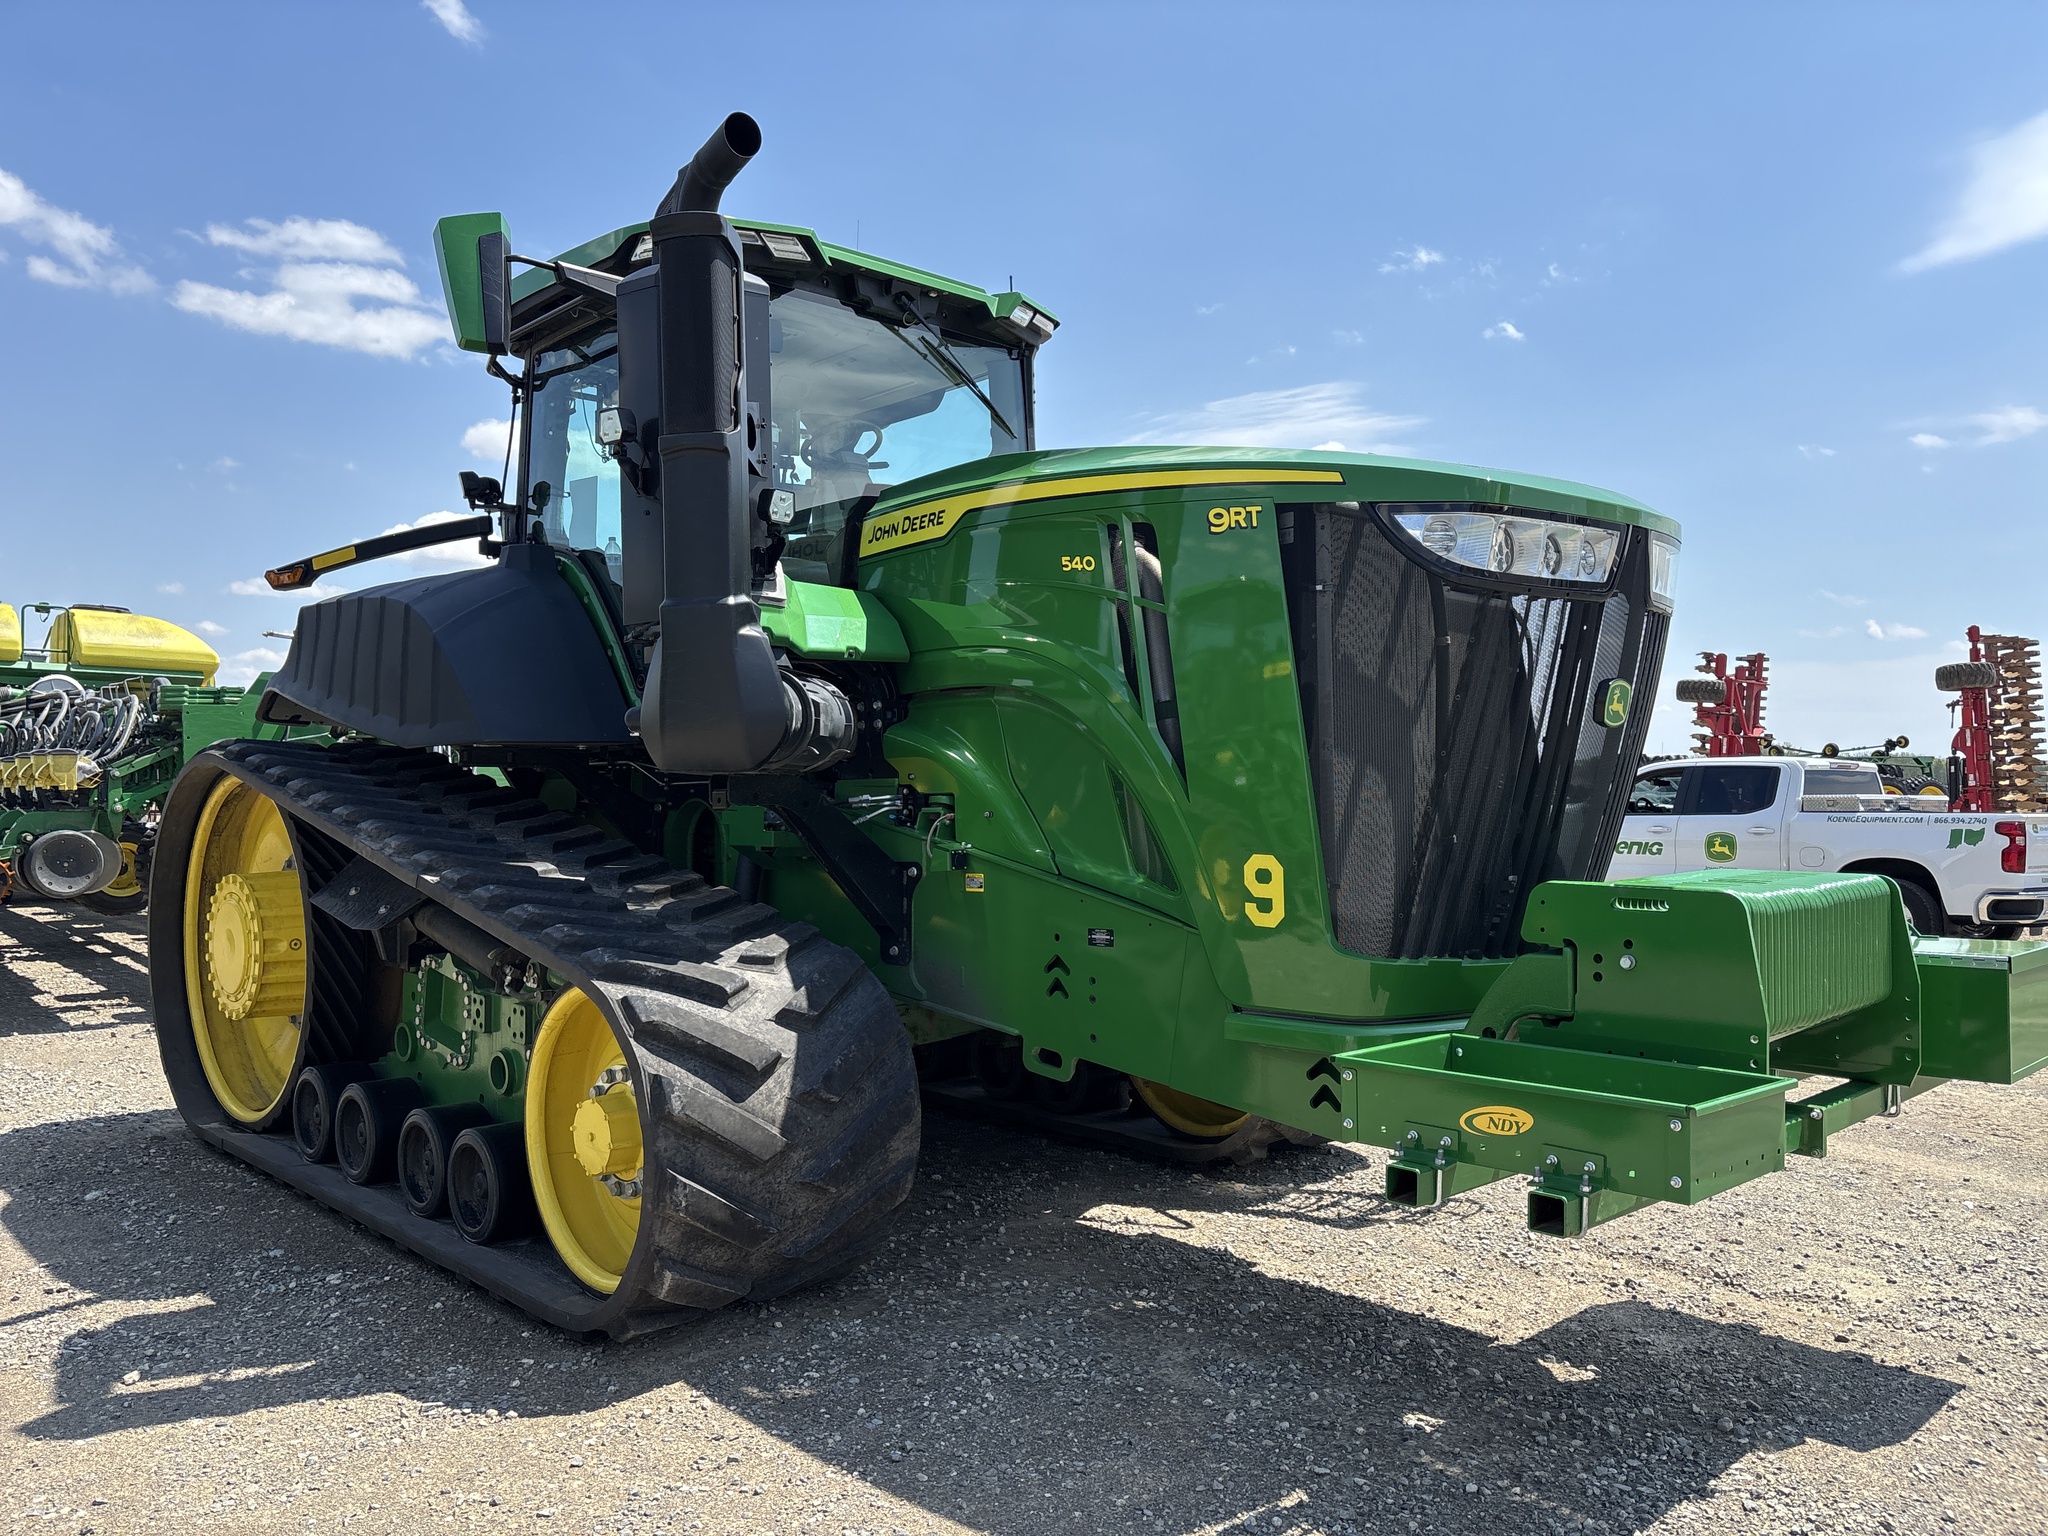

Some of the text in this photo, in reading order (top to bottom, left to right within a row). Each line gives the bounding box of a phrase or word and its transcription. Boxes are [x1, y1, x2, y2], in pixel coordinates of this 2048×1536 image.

[868, 509, 946, 545] JOHN DEERE
[1207, 505, 1262, 535] 9RT
[1061, 555, 1096, 572] 540
[1826, 815, 1923, 824] KOENIGEQUIPMENT.COM
[1933, 816, 1988, 825] 866.934.2740
[1243, 853, 1286, 928] 9
[1486, 1116, 1527, 1134] NDY
